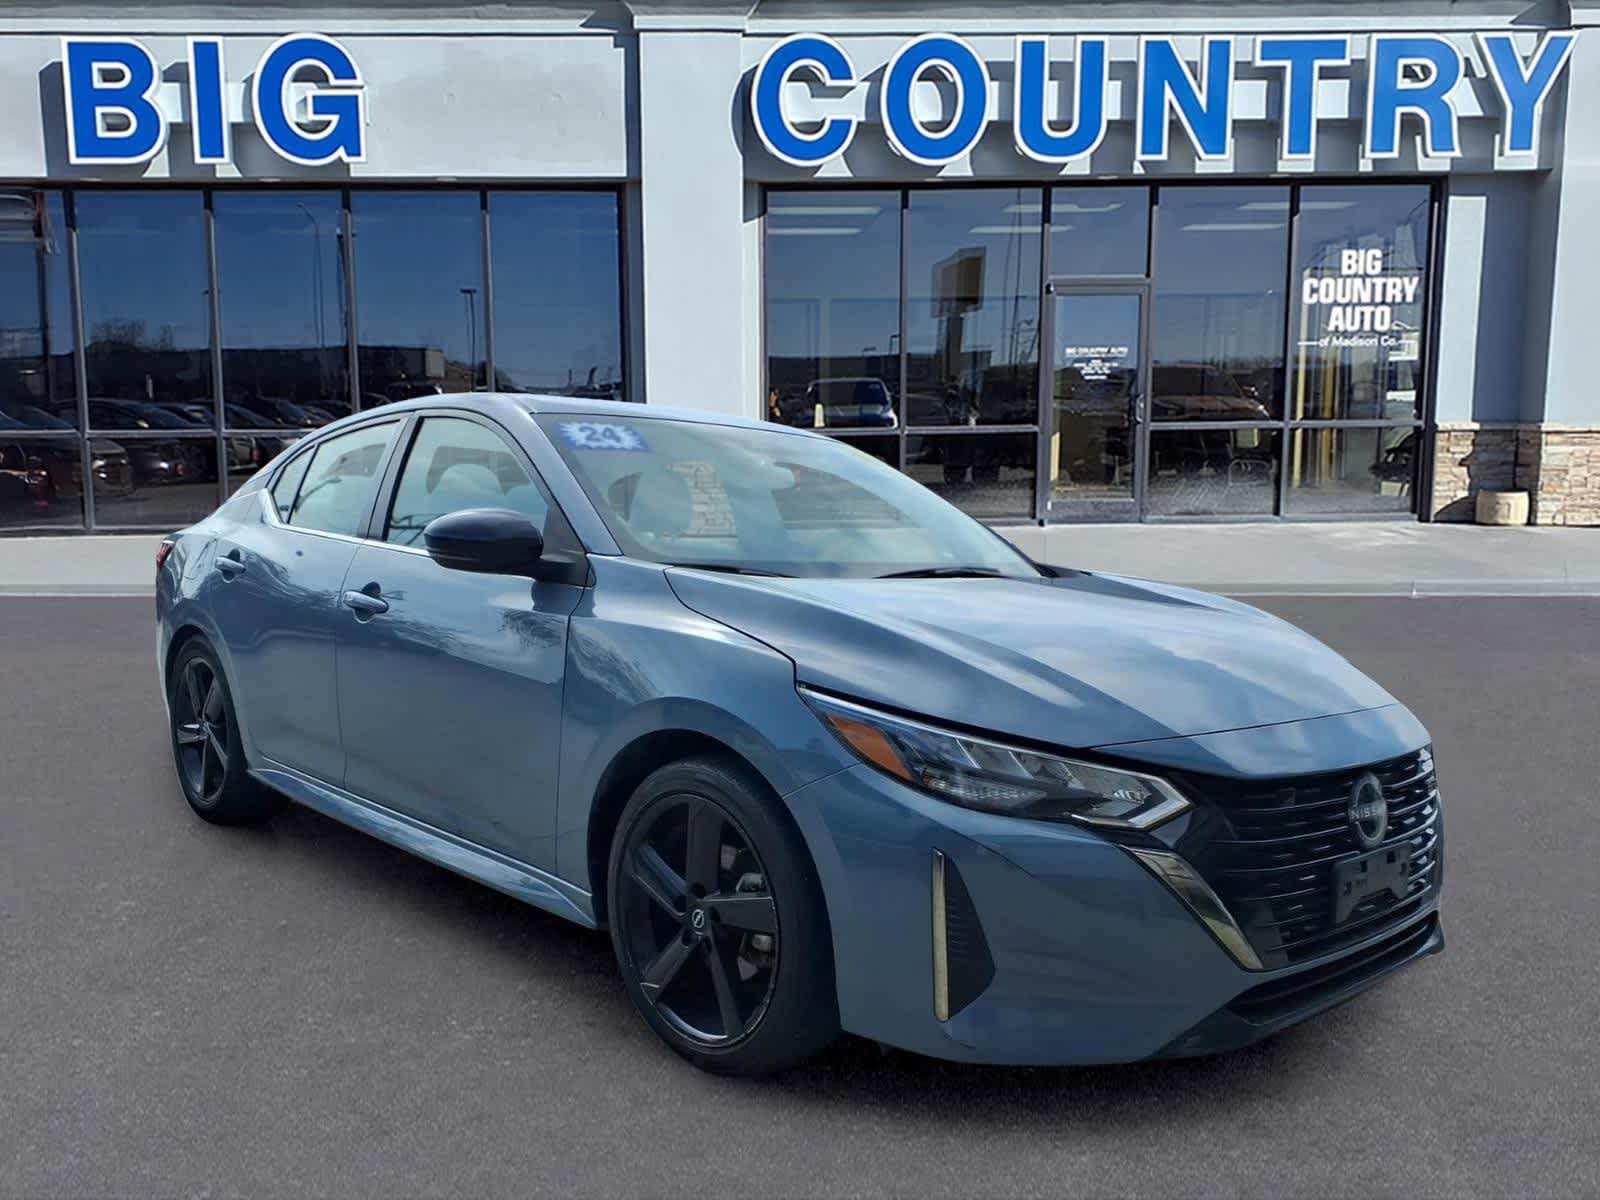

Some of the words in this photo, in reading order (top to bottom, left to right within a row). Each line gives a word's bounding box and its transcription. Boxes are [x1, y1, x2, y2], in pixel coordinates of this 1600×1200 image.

[61, 33, 367, 164] BIG
[750, 32, 1576, 166] COUNTRY
[1341, 248, 1383, 276] BIG
[1303, 276, 1420, 305] COUNTRY
[1328, 305, 1392, 332] AUTO
[1319, 336, 1329, 347] of
[1331, 336, 1378, 347] Madison
[578, 424, 622, 443] 24
